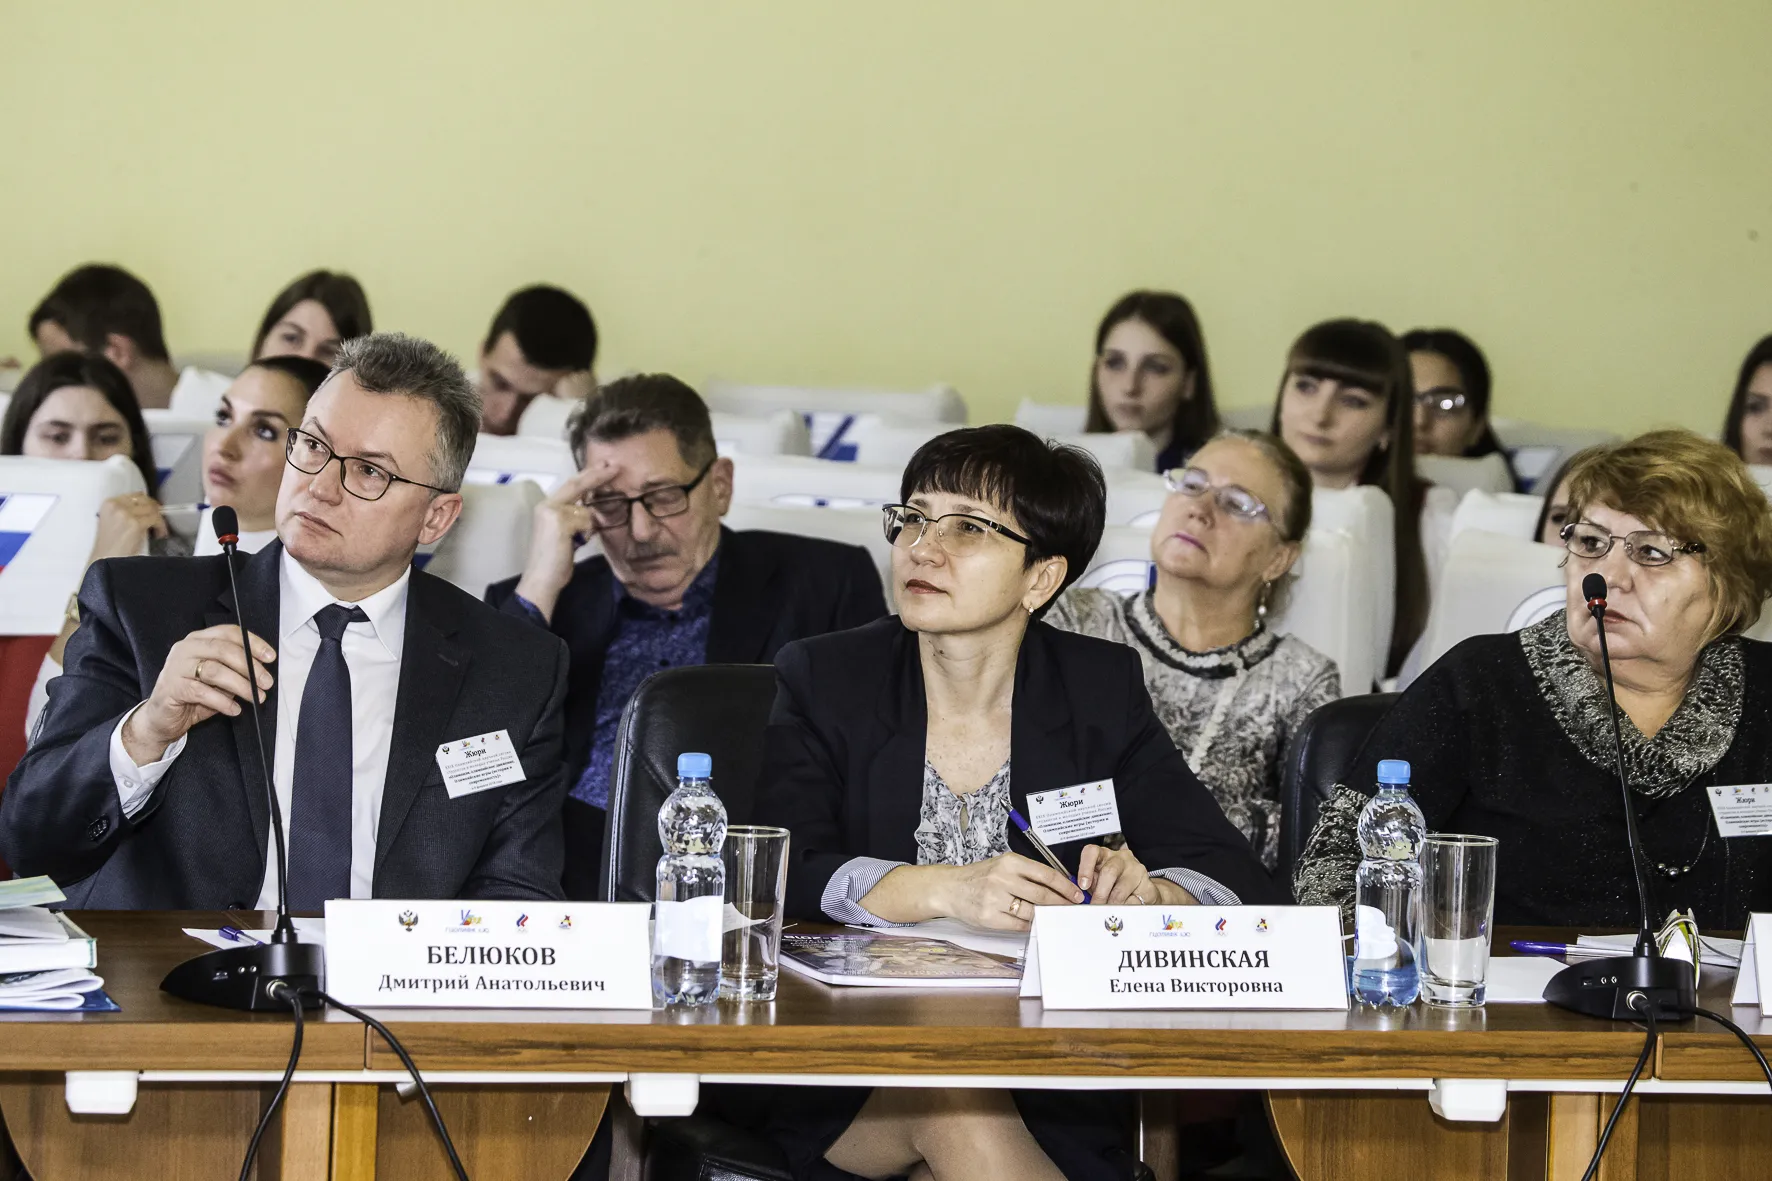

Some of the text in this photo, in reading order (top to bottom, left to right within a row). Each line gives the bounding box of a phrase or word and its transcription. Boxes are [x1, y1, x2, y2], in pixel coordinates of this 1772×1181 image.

[464, 748, 487, 758] Жюри
[1059, 799, 1084, 808] Жюри
[427, 945, 557, 966] БЕЛЮКОВ
[1118, 949, 1270, 973] ДИВИНСКАЯ
[378, 974, 606, 993] Дмитрий Анатольевич
[1109, 978, 1284, 997] Елена Викторовна
